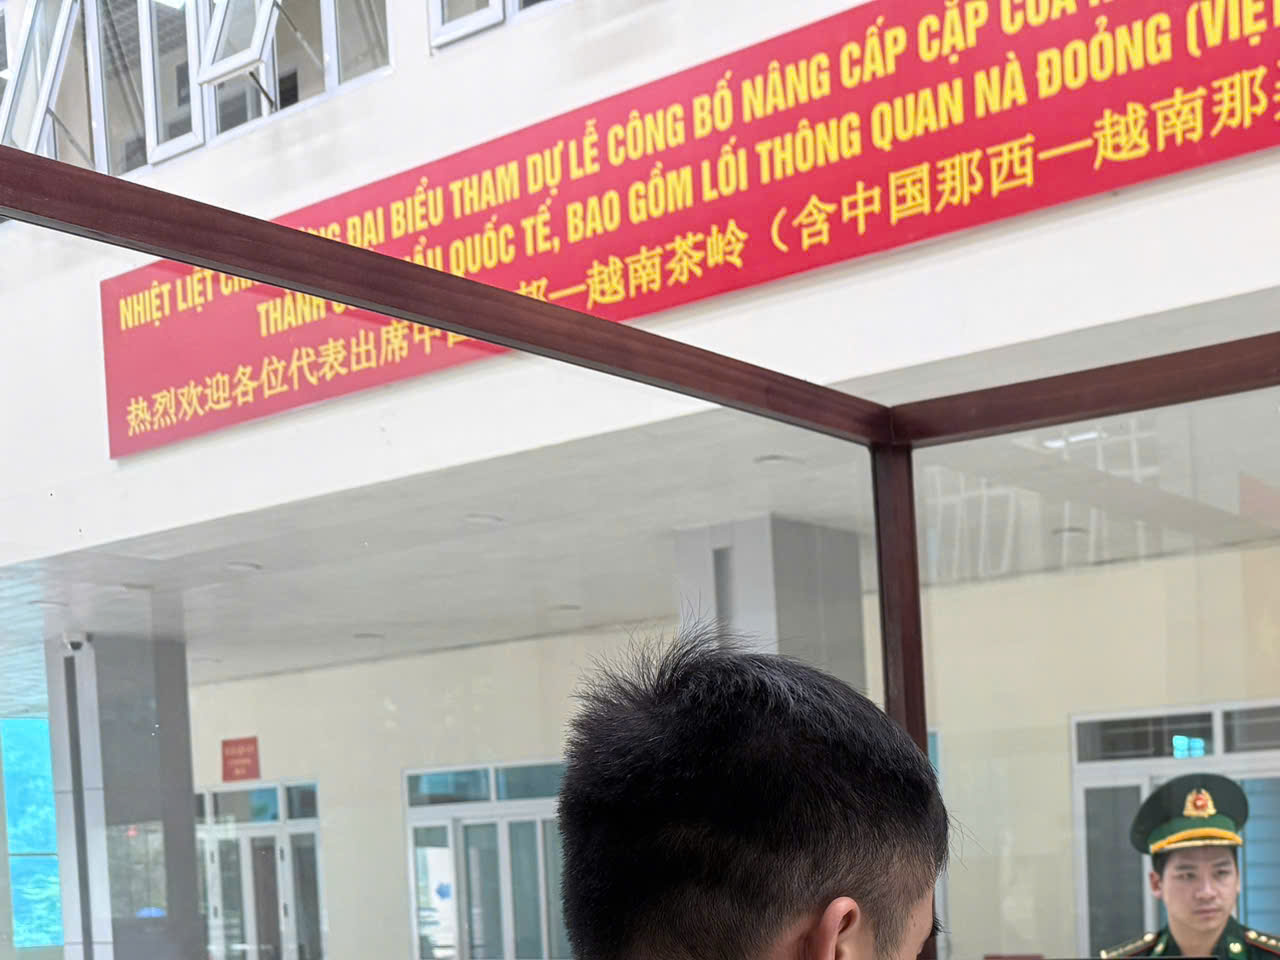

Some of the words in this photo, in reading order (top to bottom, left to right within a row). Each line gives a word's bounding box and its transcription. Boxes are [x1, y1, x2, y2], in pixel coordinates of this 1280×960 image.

[389, 178, 445, 240] BIỂU
[449, 159, 521, 219] THAM
[526, 139, 564, 197] DỰ
[568, 118, 601, 181] LỄ
[606, 104, 686, 167] CÔNG
[692, 70, 734, 139] BỐ
[741, 53, 831, 123] NÂNG
[839, 15, 908, 89] CẤP
[917, 0, 989, 65] CẶP
[449, 211, 516, 278] QUỐC
[520, 198, 561, 257] TẾ,
[567, 191, 621, 244] BAO
[628, 161, 694, 225] GỒM
[701, 137, 748, 202] LỐI
[755, 112, 862, 185] THÔNG
[871, 78, 964, 152] QUAN
[974, 50, 1028, 118] NÀ
[1036, 12, 1173, 99] ĐOỎNG
[119, 279, 172, 331] NHIỆT
[175, 267, 214, 313] LIỆT
[255, 289, 327, 337] THÀNH
[126, 318, 470, 436] 热烈欢迎各位代表出席中
